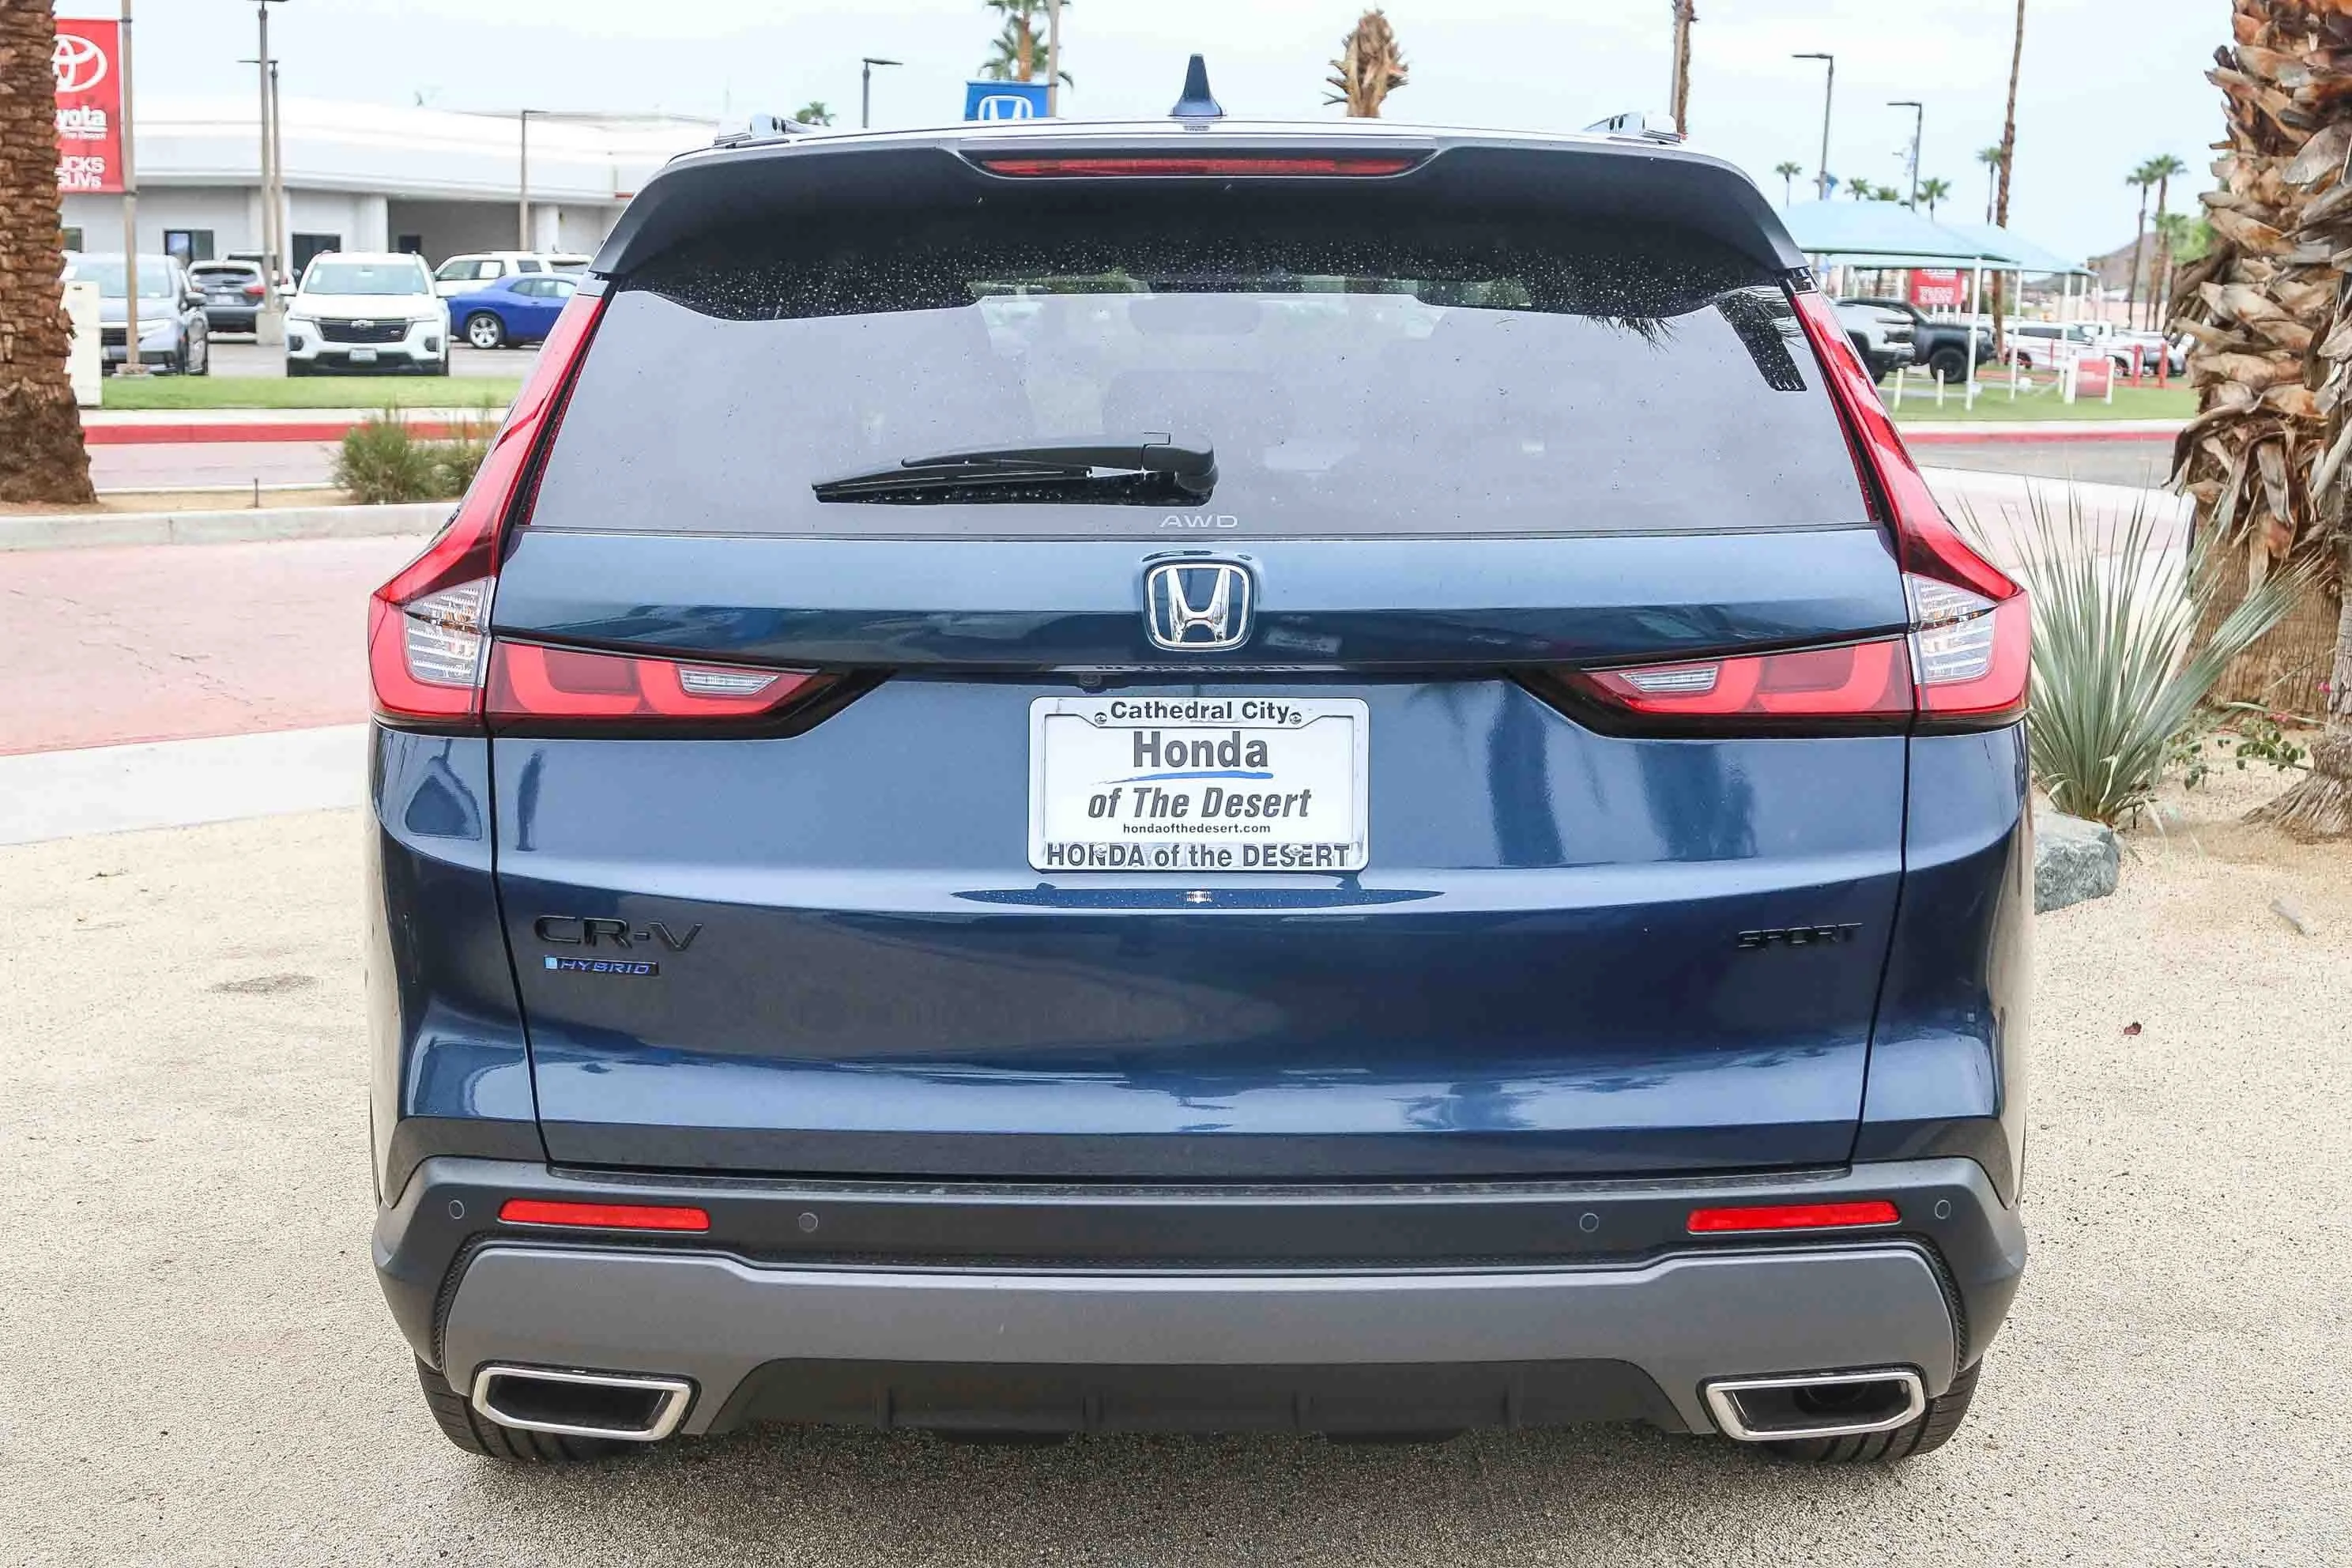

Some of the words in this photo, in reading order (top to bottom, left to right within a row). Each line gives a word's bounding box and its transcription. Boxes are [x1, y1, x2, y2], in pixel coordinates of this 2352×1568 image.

[55, 104, 107, 127] yota
[1159, 515, 1238, 527] AWD
[1110, 701, 1232, 720] Cathedral
[1242, 701, 1289, 724] City
[1133, 730, 1269, 767] Honda
[1088, 788, 1121, 819] of
[1133, 788, 1189, 818] The
[1201, 788, 1312, 818] Desert
[1122, 824, 1271, 835] hondaofthedesert.com
[1046, 843, 1145, 866] HONDA
[1155, 844, 1180, 866] of
[1189, 844, 1233, 867] the
[1242, 843, 1350, 867] DESERT
[534, 915, 703, 952] CR-V
[1736, 922, 1863, 952] SPORT
[560, 959, 651, 974] HYBRID
